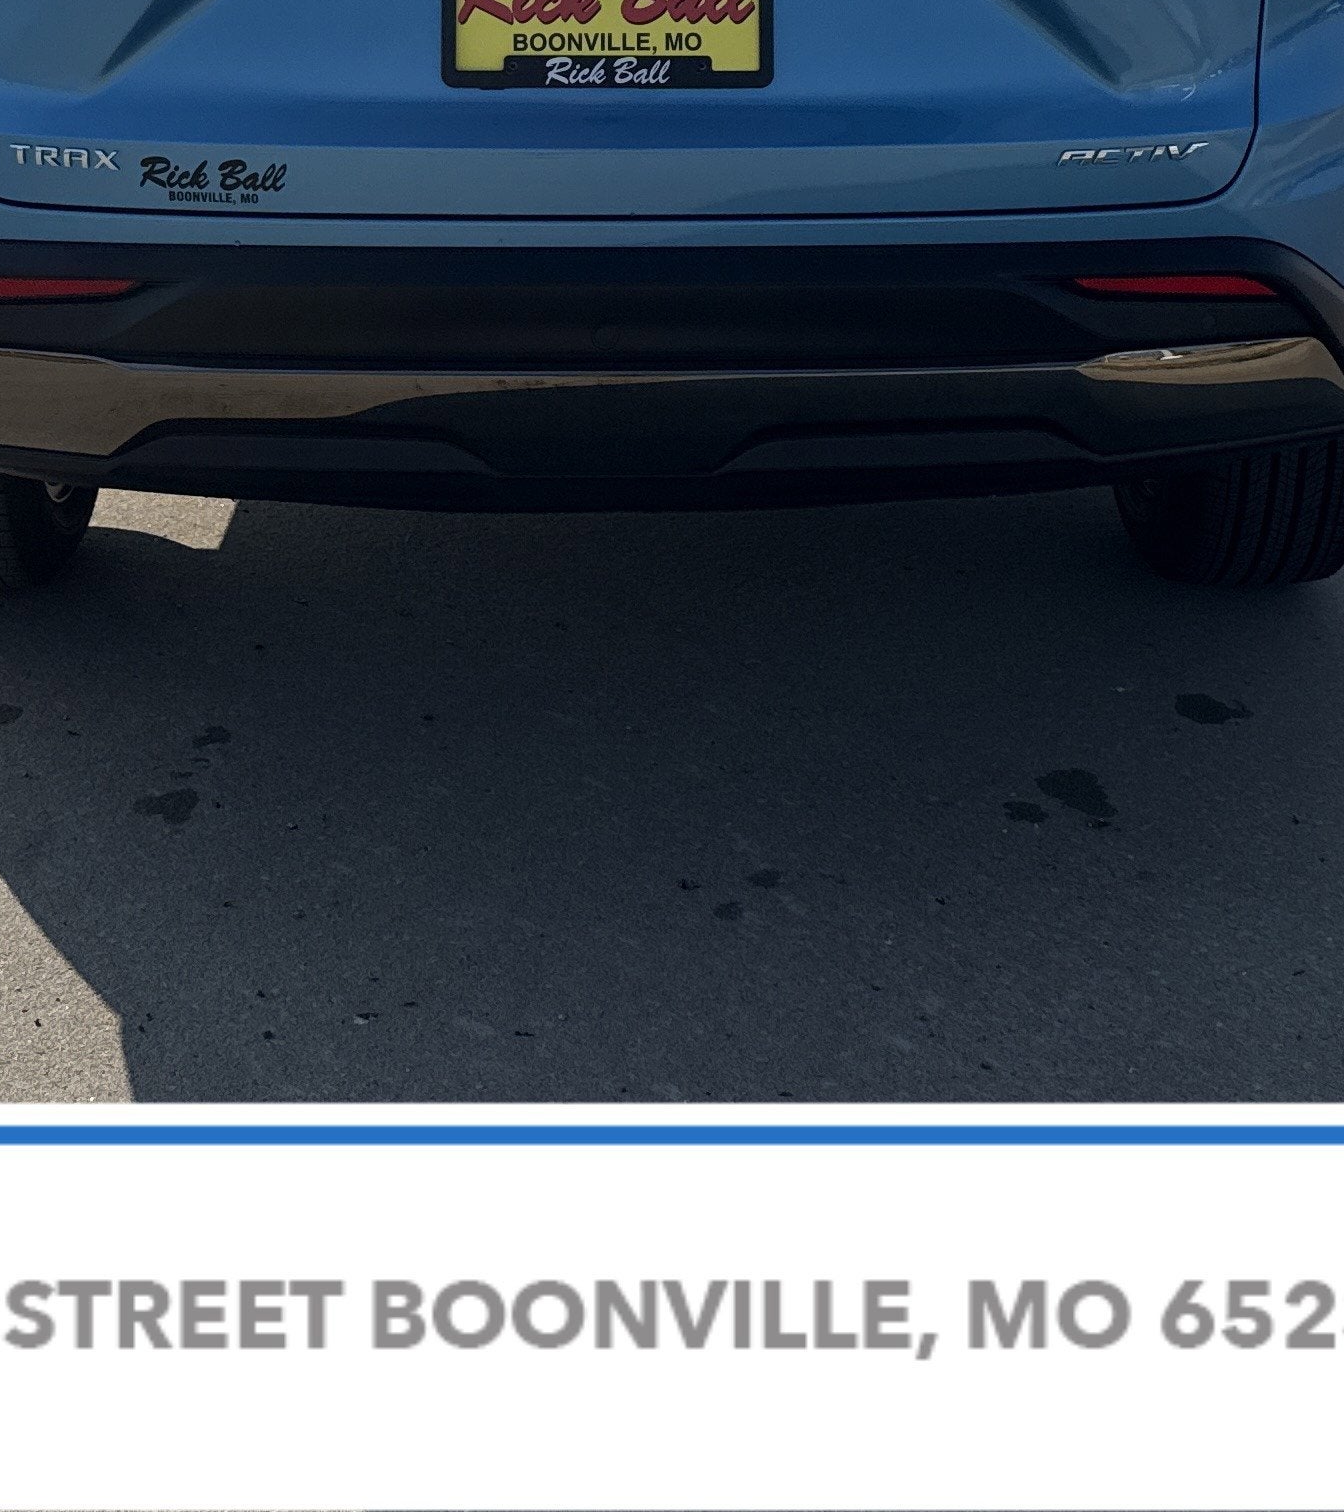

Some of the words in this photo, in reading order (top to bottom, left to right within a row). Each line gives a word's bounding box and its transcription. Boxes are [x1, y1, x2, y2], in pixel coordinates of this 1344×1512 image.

[513, 33, 657, 54] BOONVILLE,
[665, 33, 702, 51] MO
[545, 57, 606, 85] Rick
[613, 57, 670, 85] Ball
[9, 143, 121, 171] TRAX
[1056, 142, 1210, 167] ACTIV
[139, 156, 210, 188] Rick
[217, 159, 287, 193] Ball
[168, 190, 237, 205] BOONVILLE,
[240, 193, 259, 204] MO
